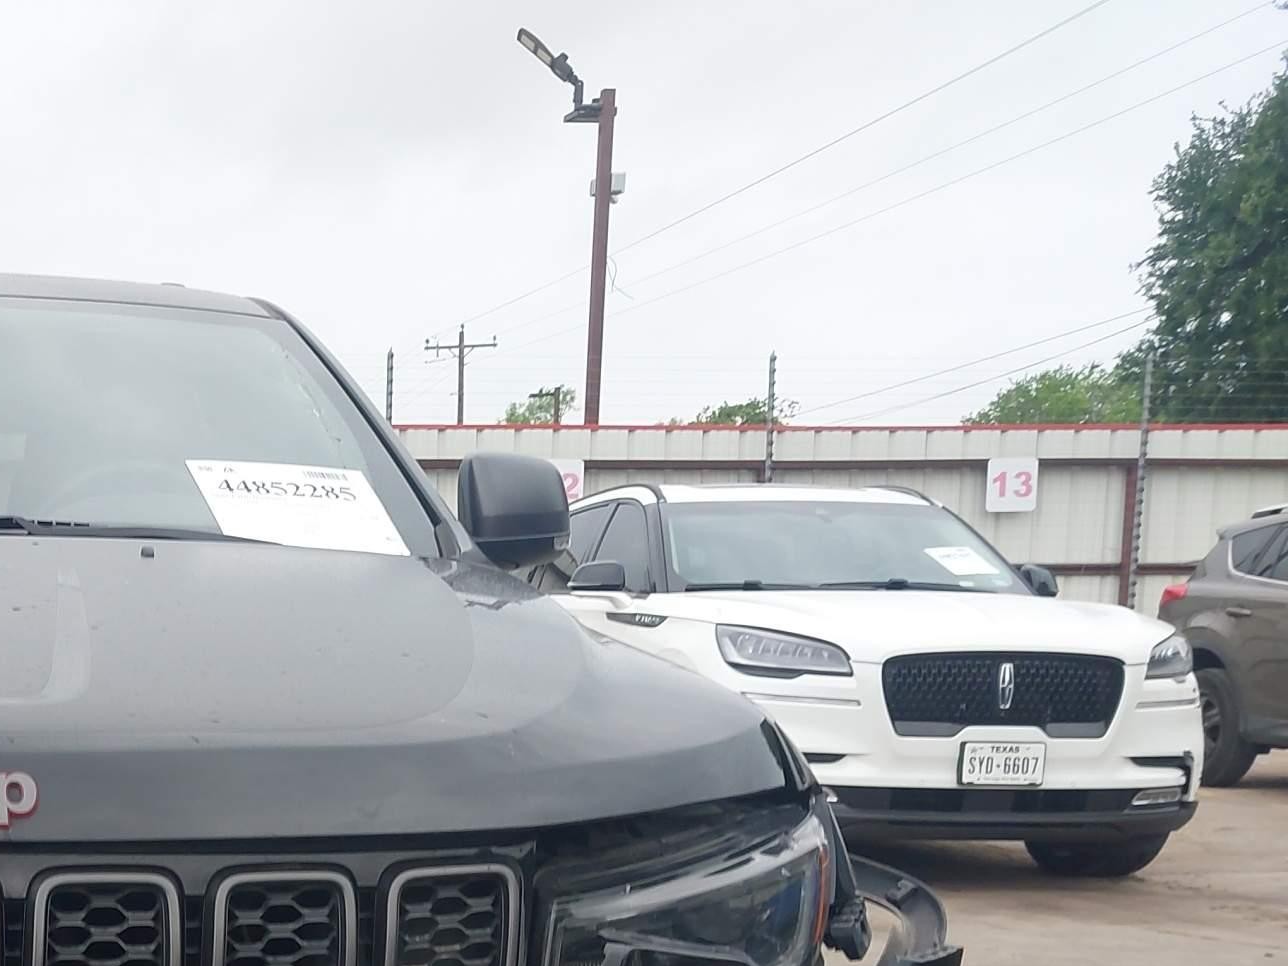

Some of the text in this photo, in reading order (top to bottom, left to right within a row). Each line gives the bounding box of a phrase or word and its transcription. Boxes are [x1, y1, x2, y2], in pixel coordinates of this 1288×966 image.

[217, 478, 357, 502] 44852285
[562, 472, 579, 500] 2
[992, 471, 1033, 498] 13
[990, 745, 1020, 754] TEXAS
